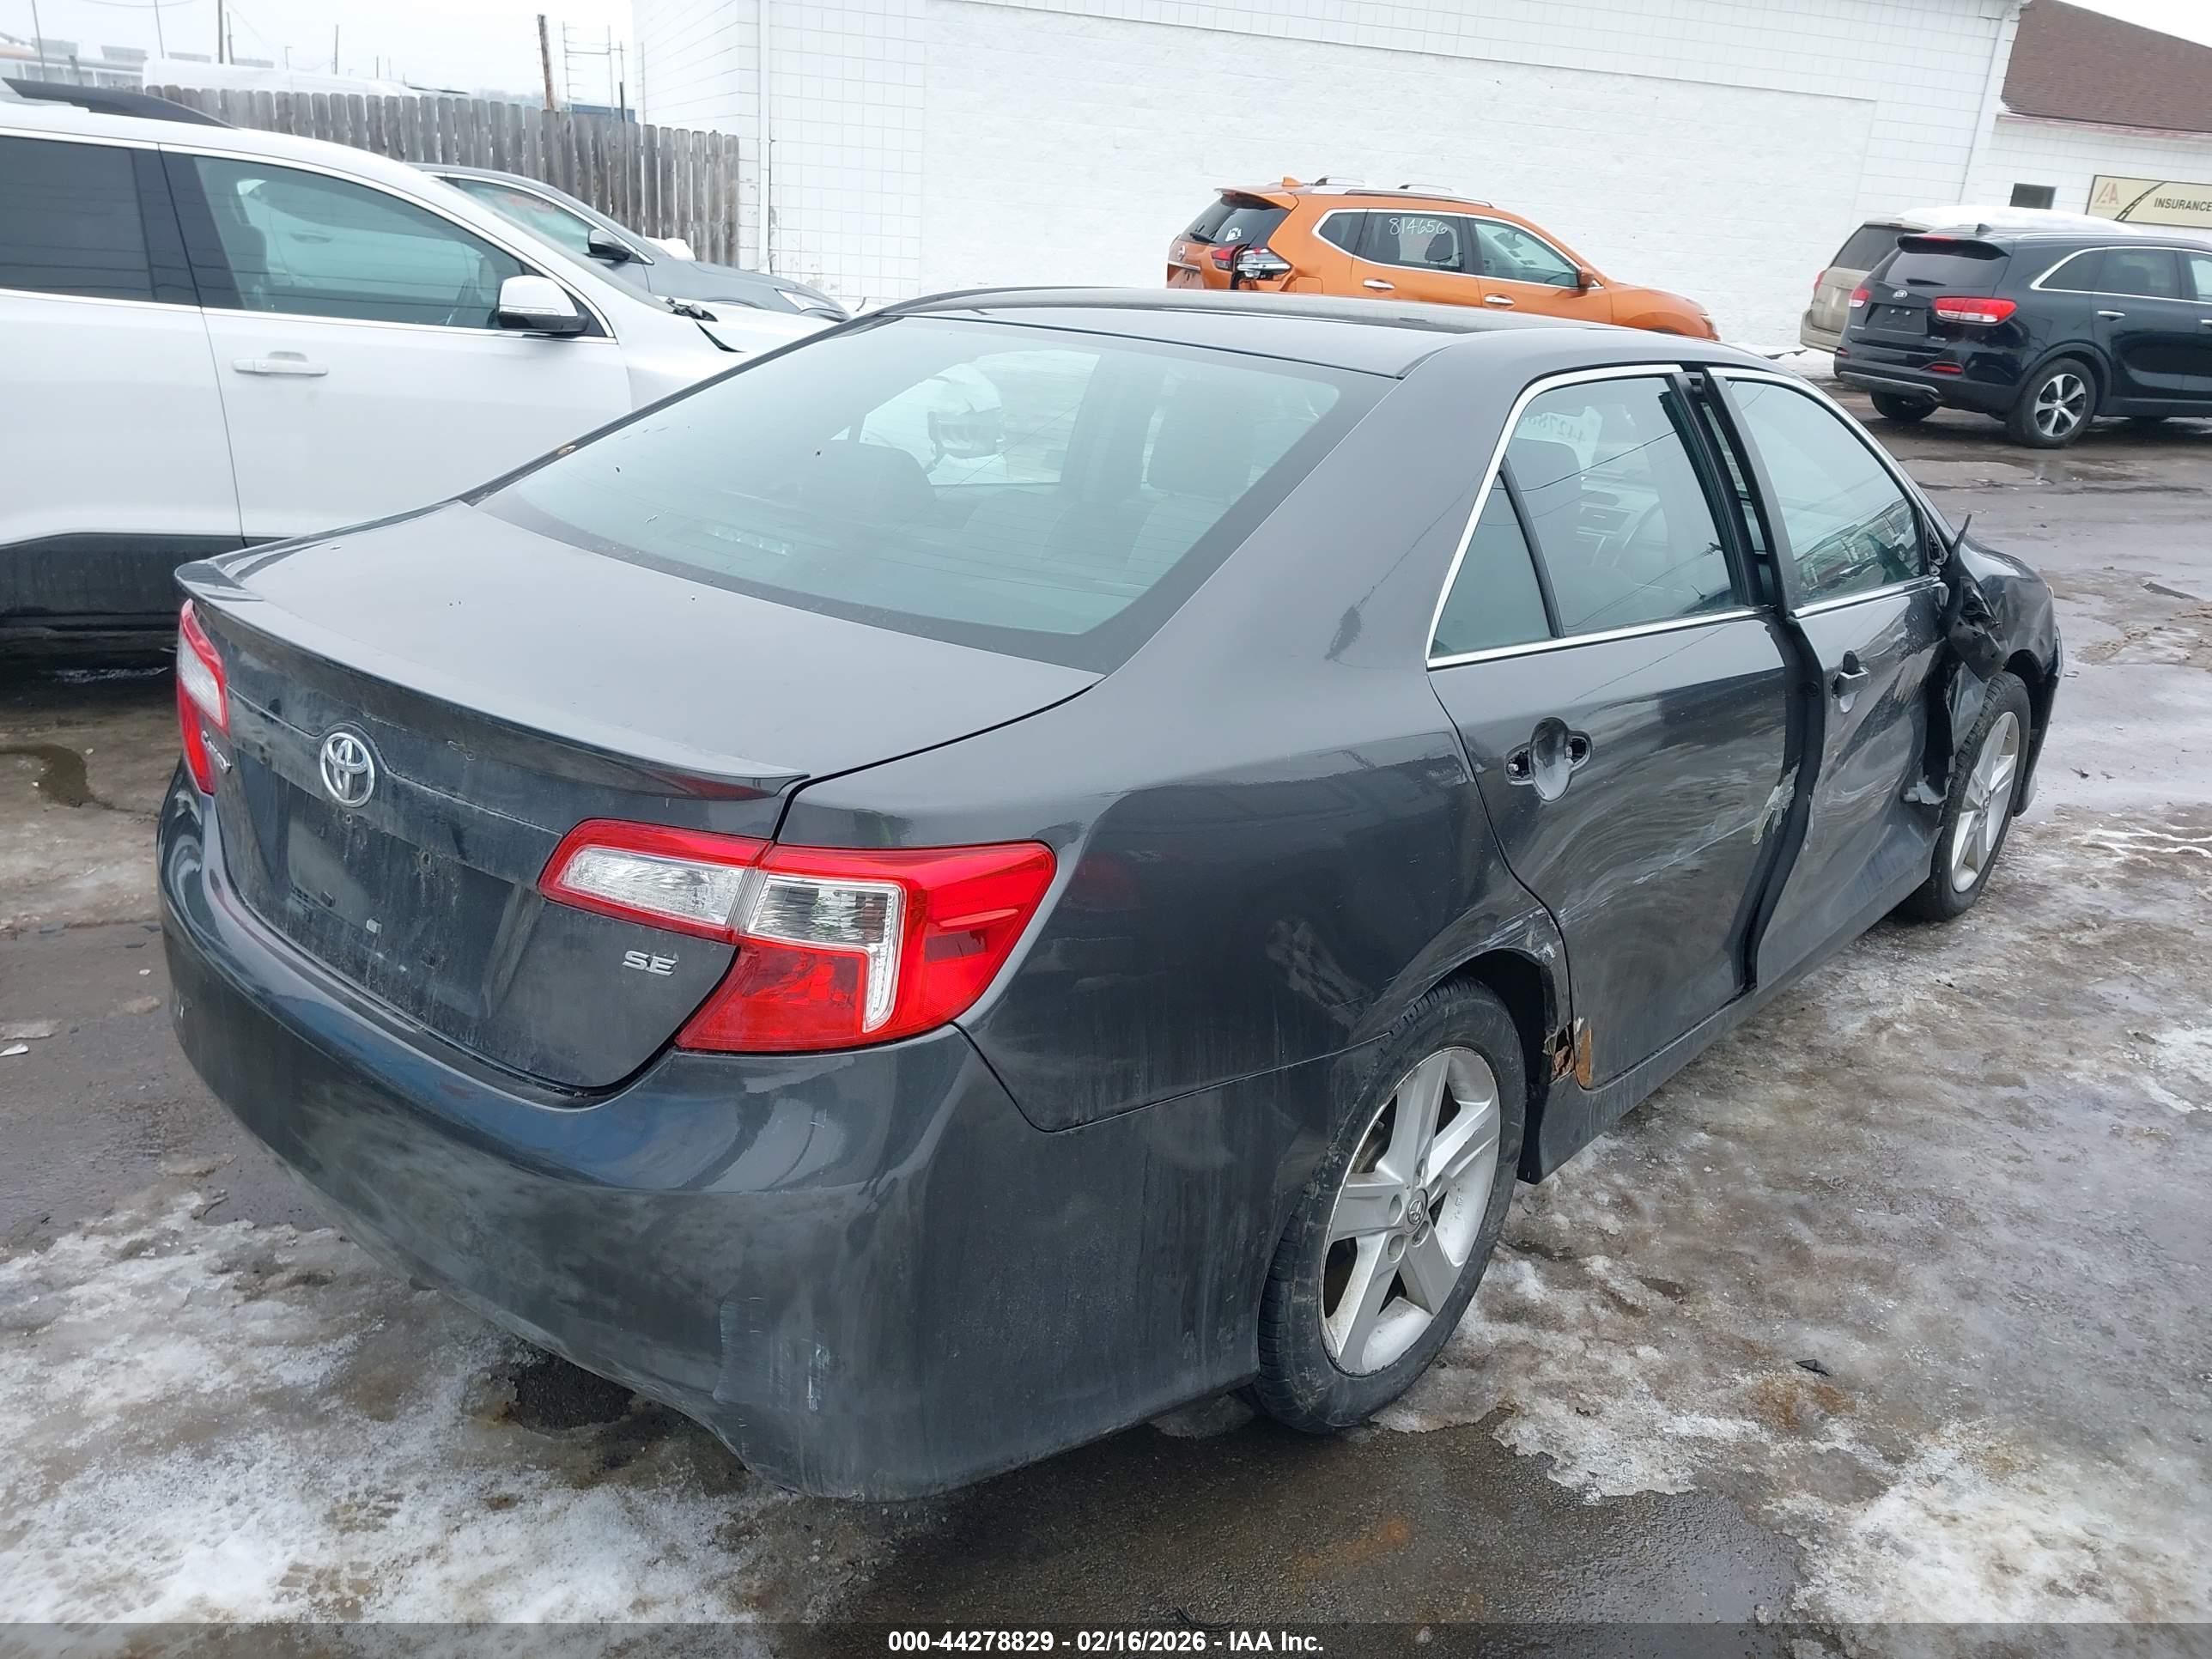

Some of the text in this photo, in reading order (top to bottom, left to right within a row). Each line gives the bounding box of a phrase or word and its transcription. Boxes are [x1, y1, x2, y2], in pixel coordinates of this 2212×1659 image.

[2154, 197, 2212, 212] INSURANCE
[1389, 217, 1449, 235] 814656
[622, 950, 678, 976] SE
